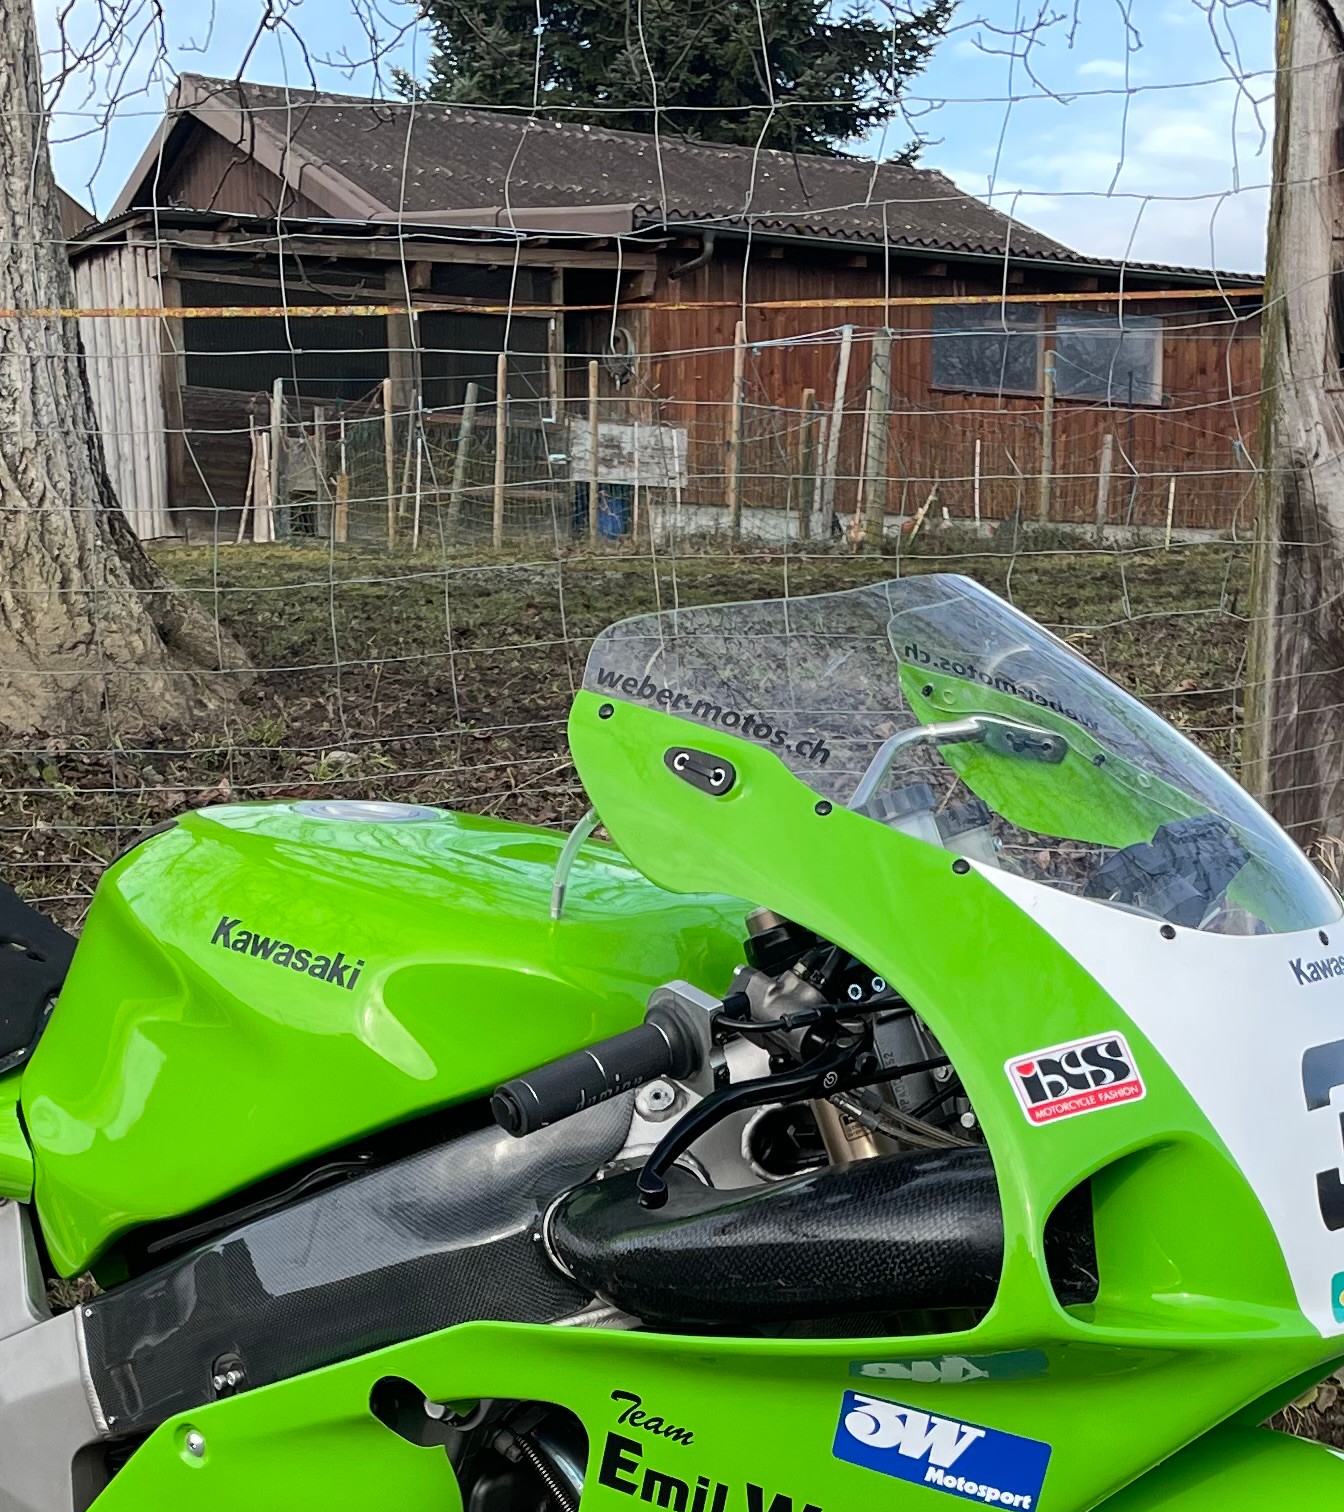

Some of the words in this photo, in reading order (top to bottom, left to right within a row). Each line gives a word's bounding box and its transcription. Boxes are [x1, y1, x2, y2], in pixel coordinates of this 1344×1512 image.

[596, 667, 831, 764] weber-motos.ch
[210, 915, 365, 991] Kawasaki
[610, 1389, 694, 1446] Team
[924, 1466, 1033, 1510] Motosport
